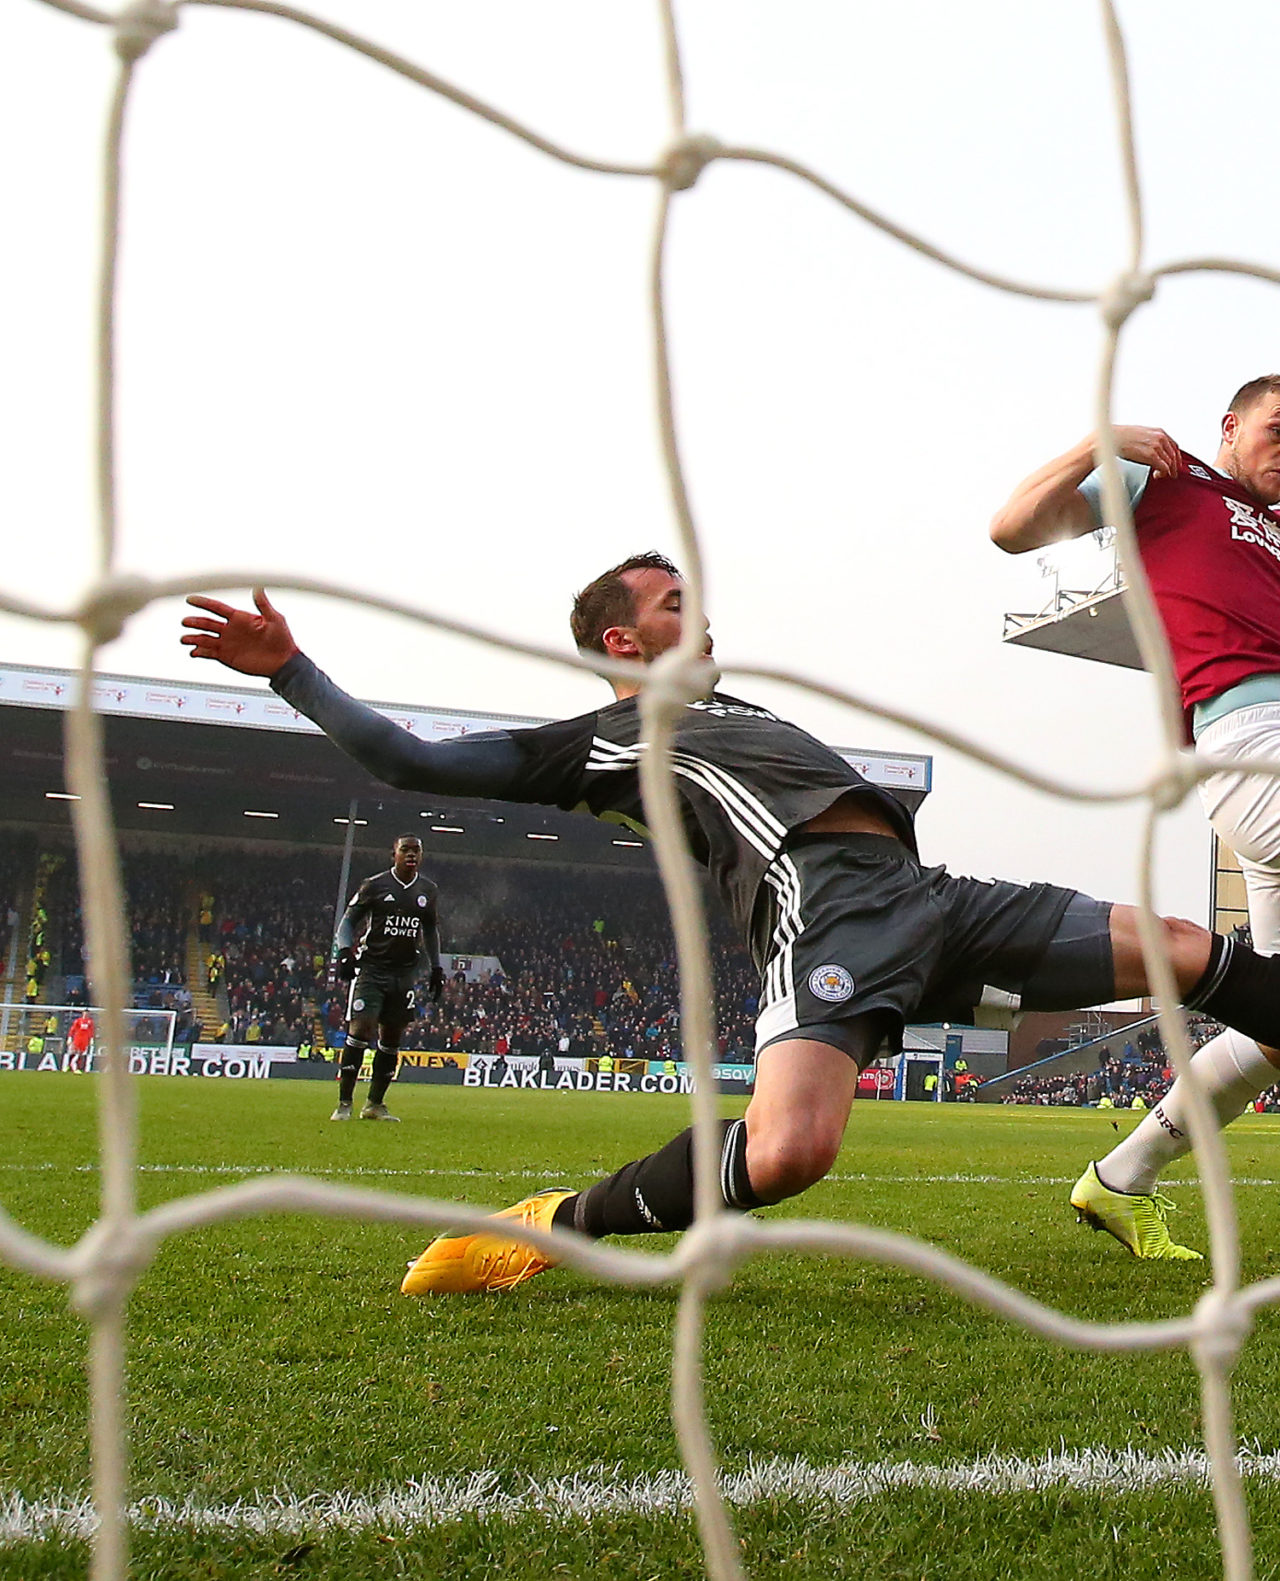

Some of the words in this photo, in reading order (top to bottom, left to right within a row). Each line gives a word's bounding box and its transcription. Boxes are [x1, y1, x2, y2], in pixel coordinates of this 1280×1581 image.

[384, 926, 418, 938] POWER
[385, 915, 420, 928] KING
[0, 1051, 271, 1079] BLAKLDER.COM
[463, 1066, 698, 1094] BLAKLADER.COM
[1155, 1107, 1184, 1139] BFC
